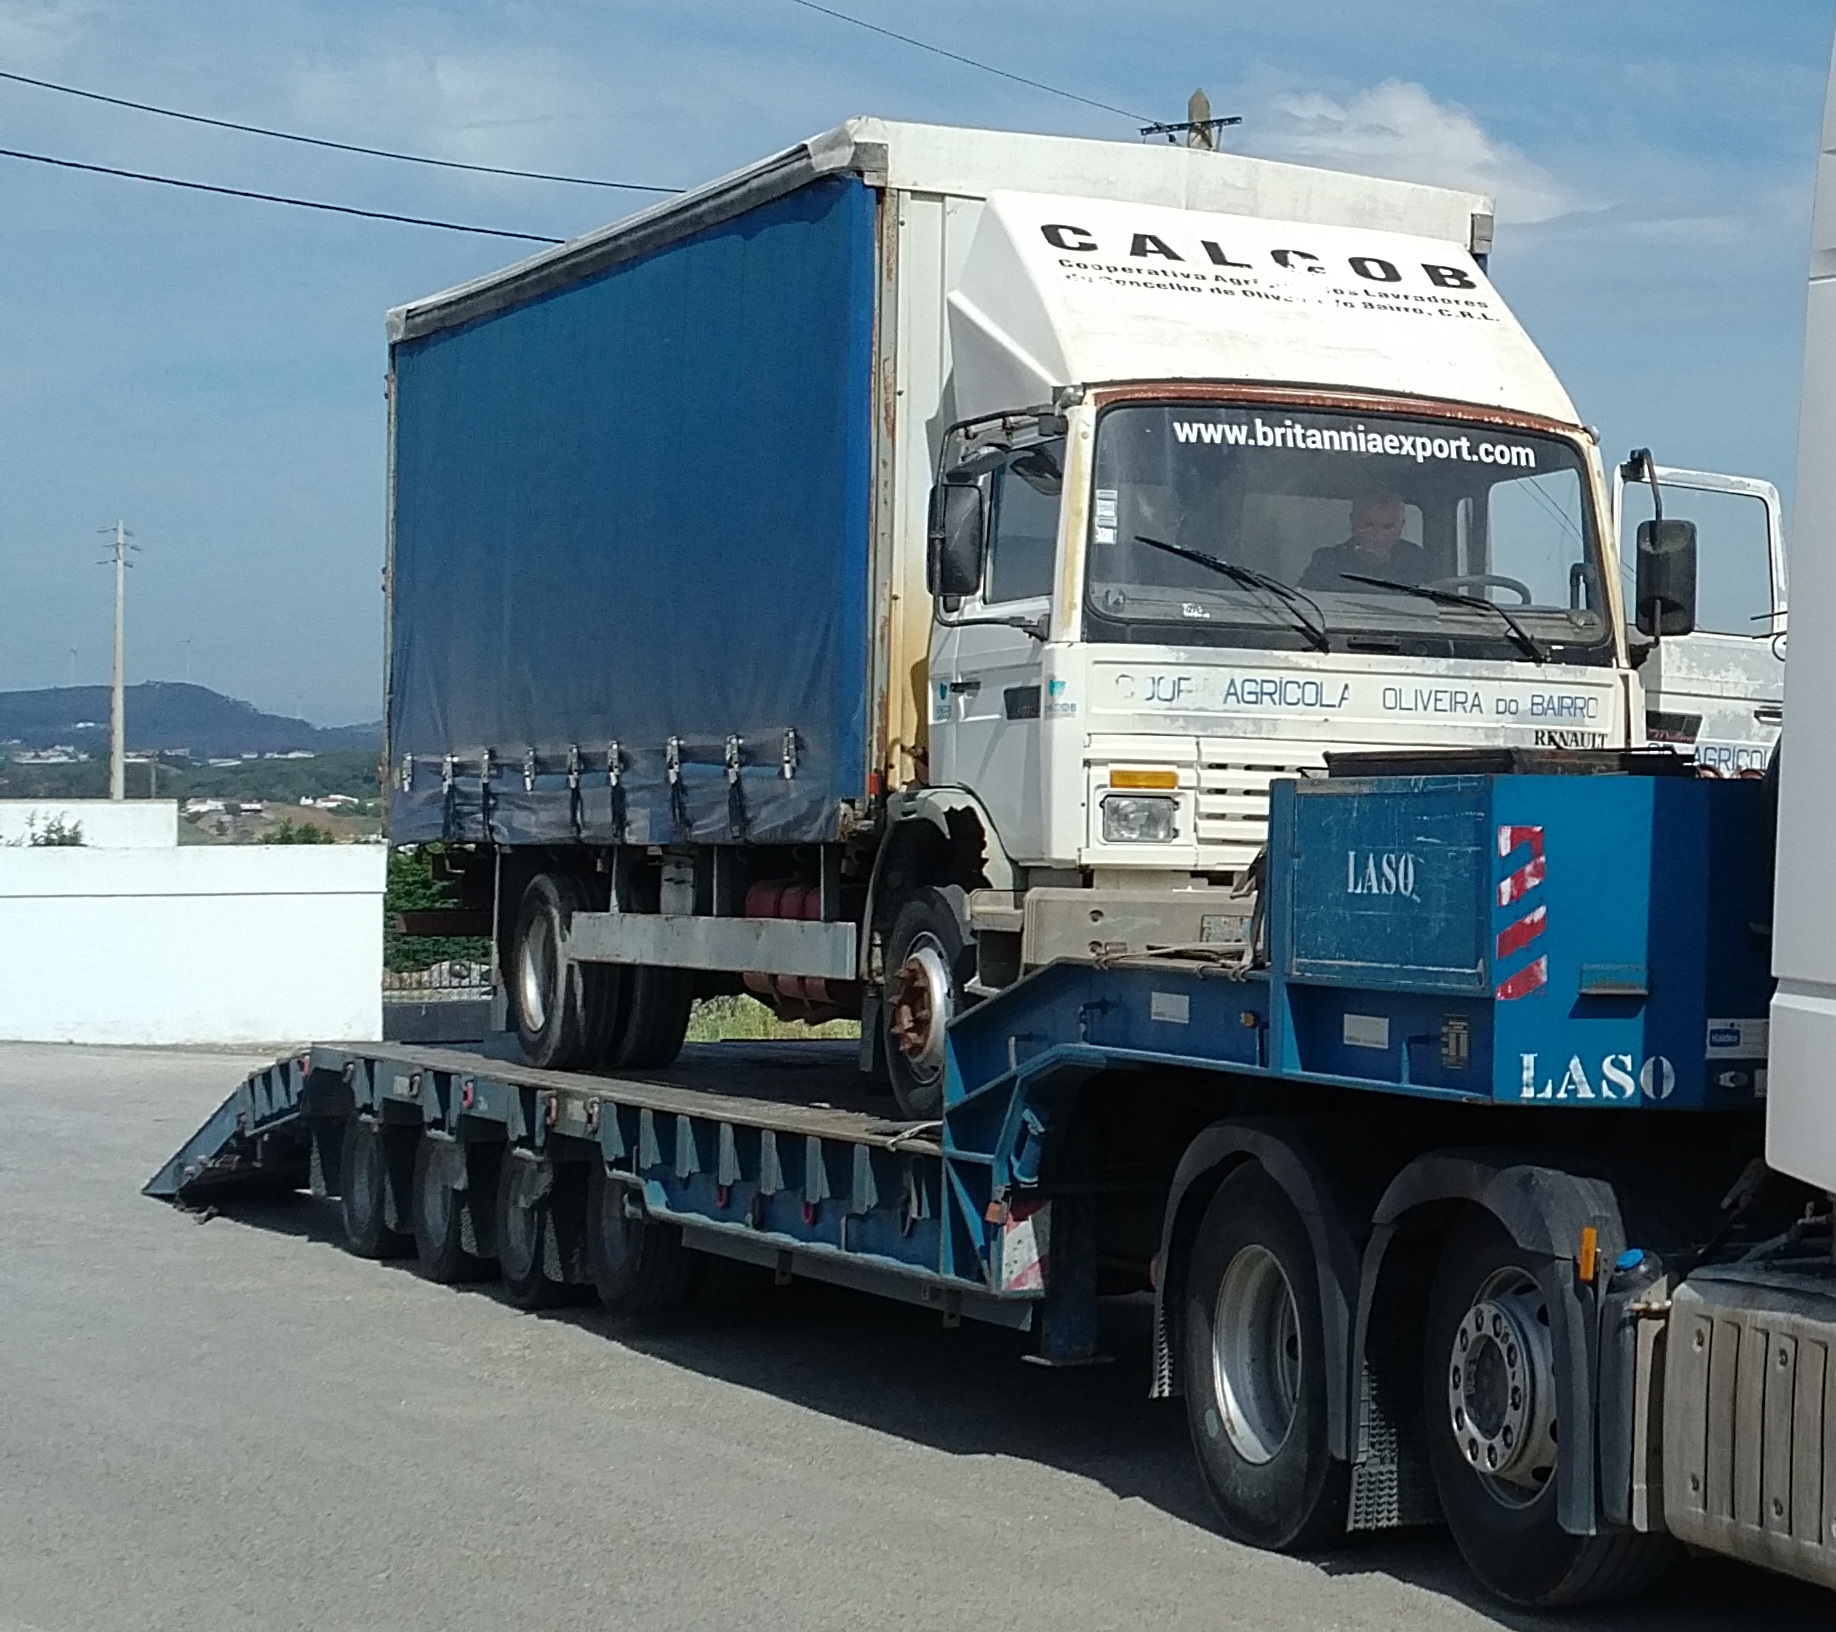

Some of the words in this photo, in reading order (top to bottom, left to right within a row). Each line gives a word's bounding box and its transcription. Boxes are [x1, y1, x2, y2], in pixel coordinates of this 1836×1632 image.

[1057, 258, 1207, 282] Cooperativa
[1363, 288, 1490, 309] Lavradores
[1173, 418, 1536, 468] www.britanniaexport.com
[1382, 687, 1485, 715] OLIVEIRA
[1519, 1053, 1676, 1100] LASO
